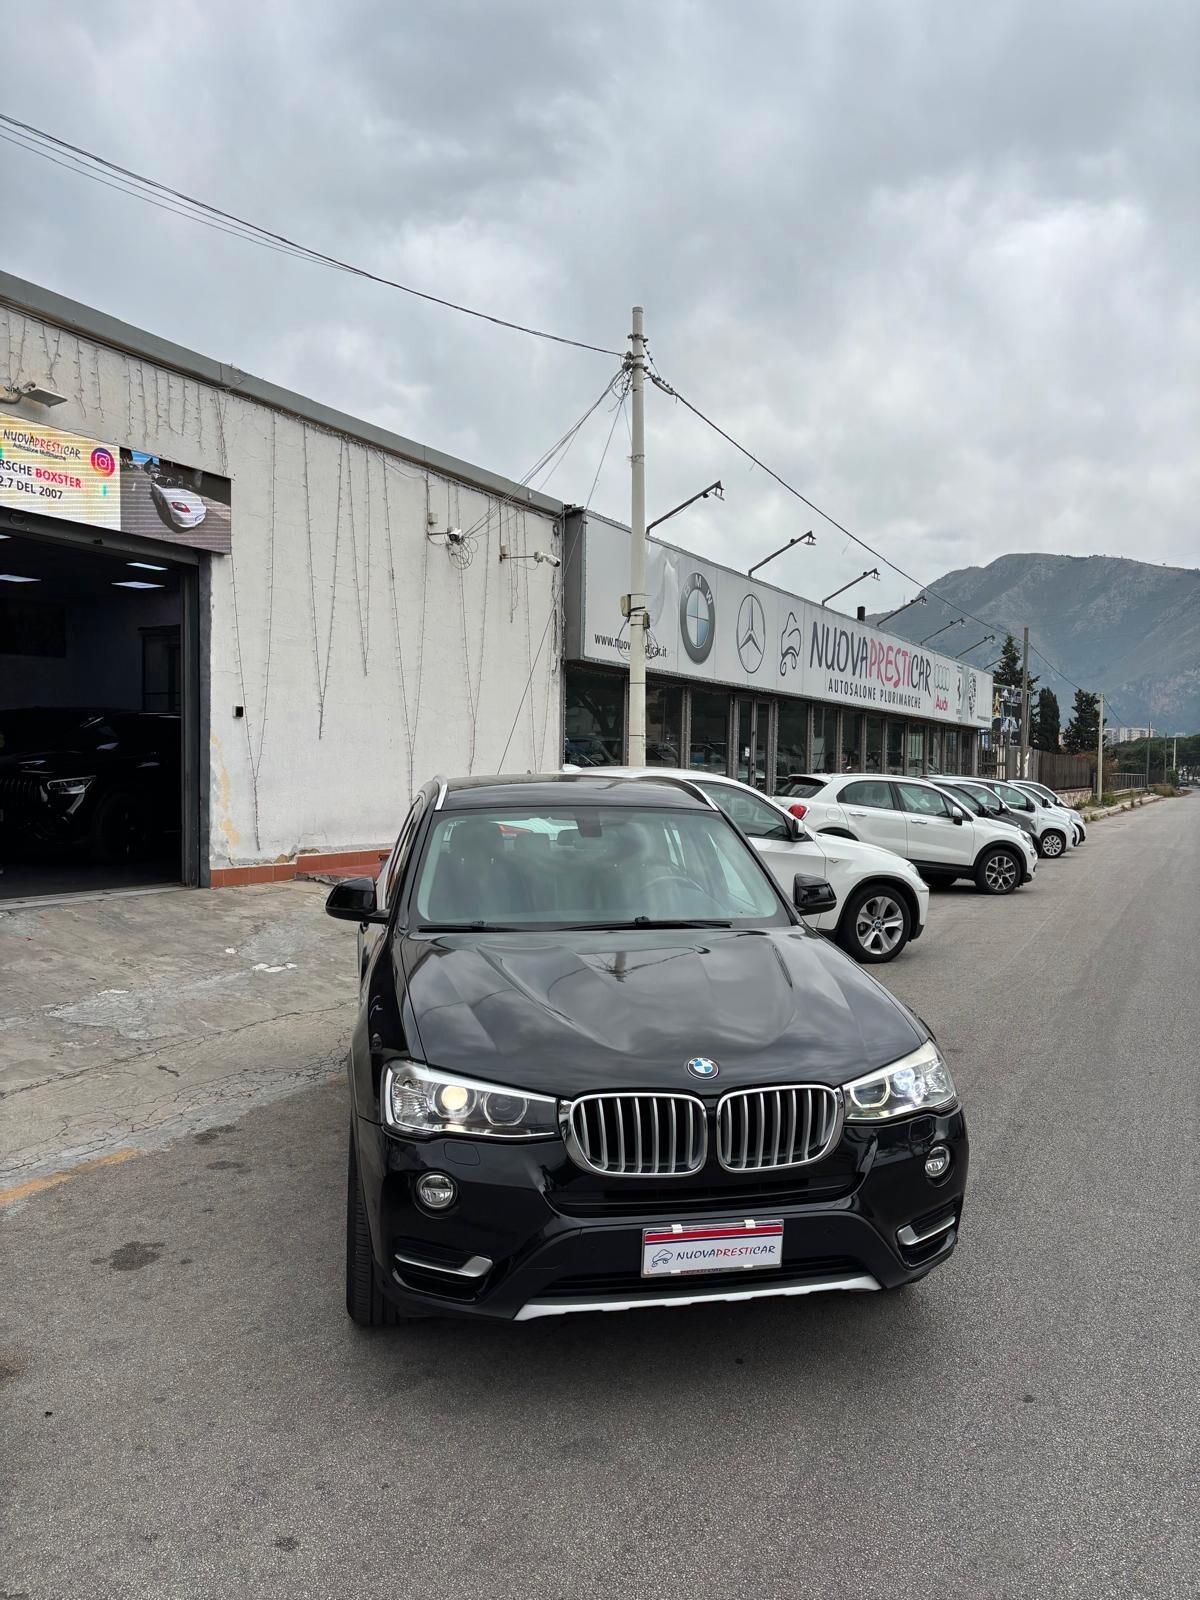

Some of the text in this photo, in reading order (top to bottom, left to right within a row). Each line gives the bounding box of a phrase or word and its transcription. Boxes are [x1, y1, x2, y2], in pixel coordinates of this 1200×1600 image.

[0, 475, 63, 500] 2.7 DEL 2007
[35, 468, 82, 489] BOXSTER
[828, 677, 921, 709] AUTOSALONE PLURIMARCHE
